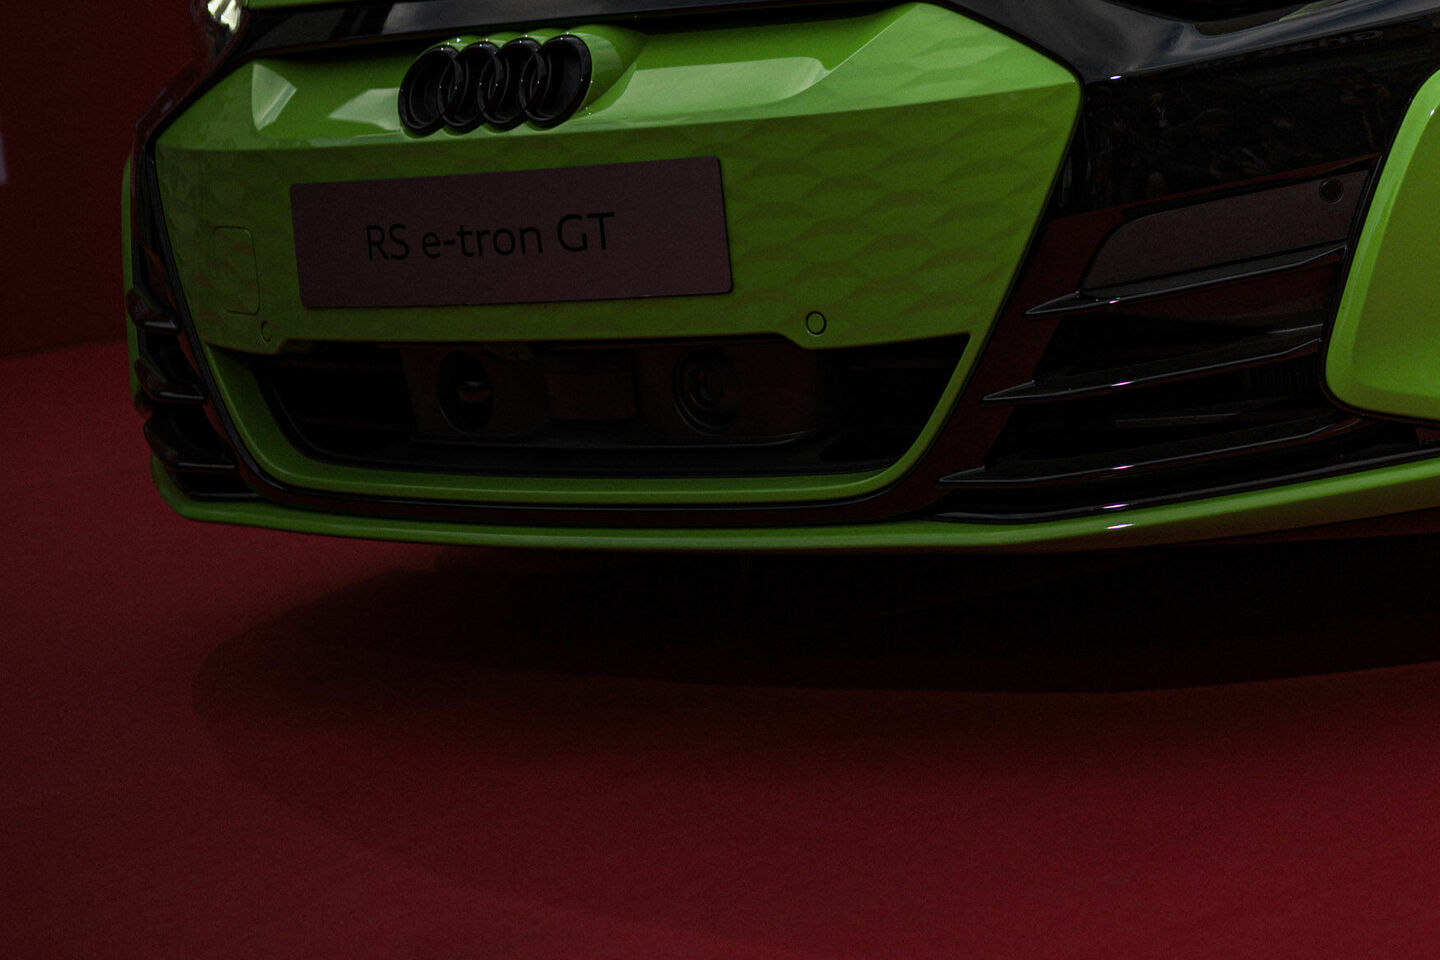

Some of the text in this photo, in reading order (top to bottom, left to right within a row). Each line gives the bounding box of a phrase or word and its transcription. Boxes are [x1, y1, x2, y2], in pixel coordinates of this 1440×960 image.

[367, 212, 615, 261] RS e-tron GT
